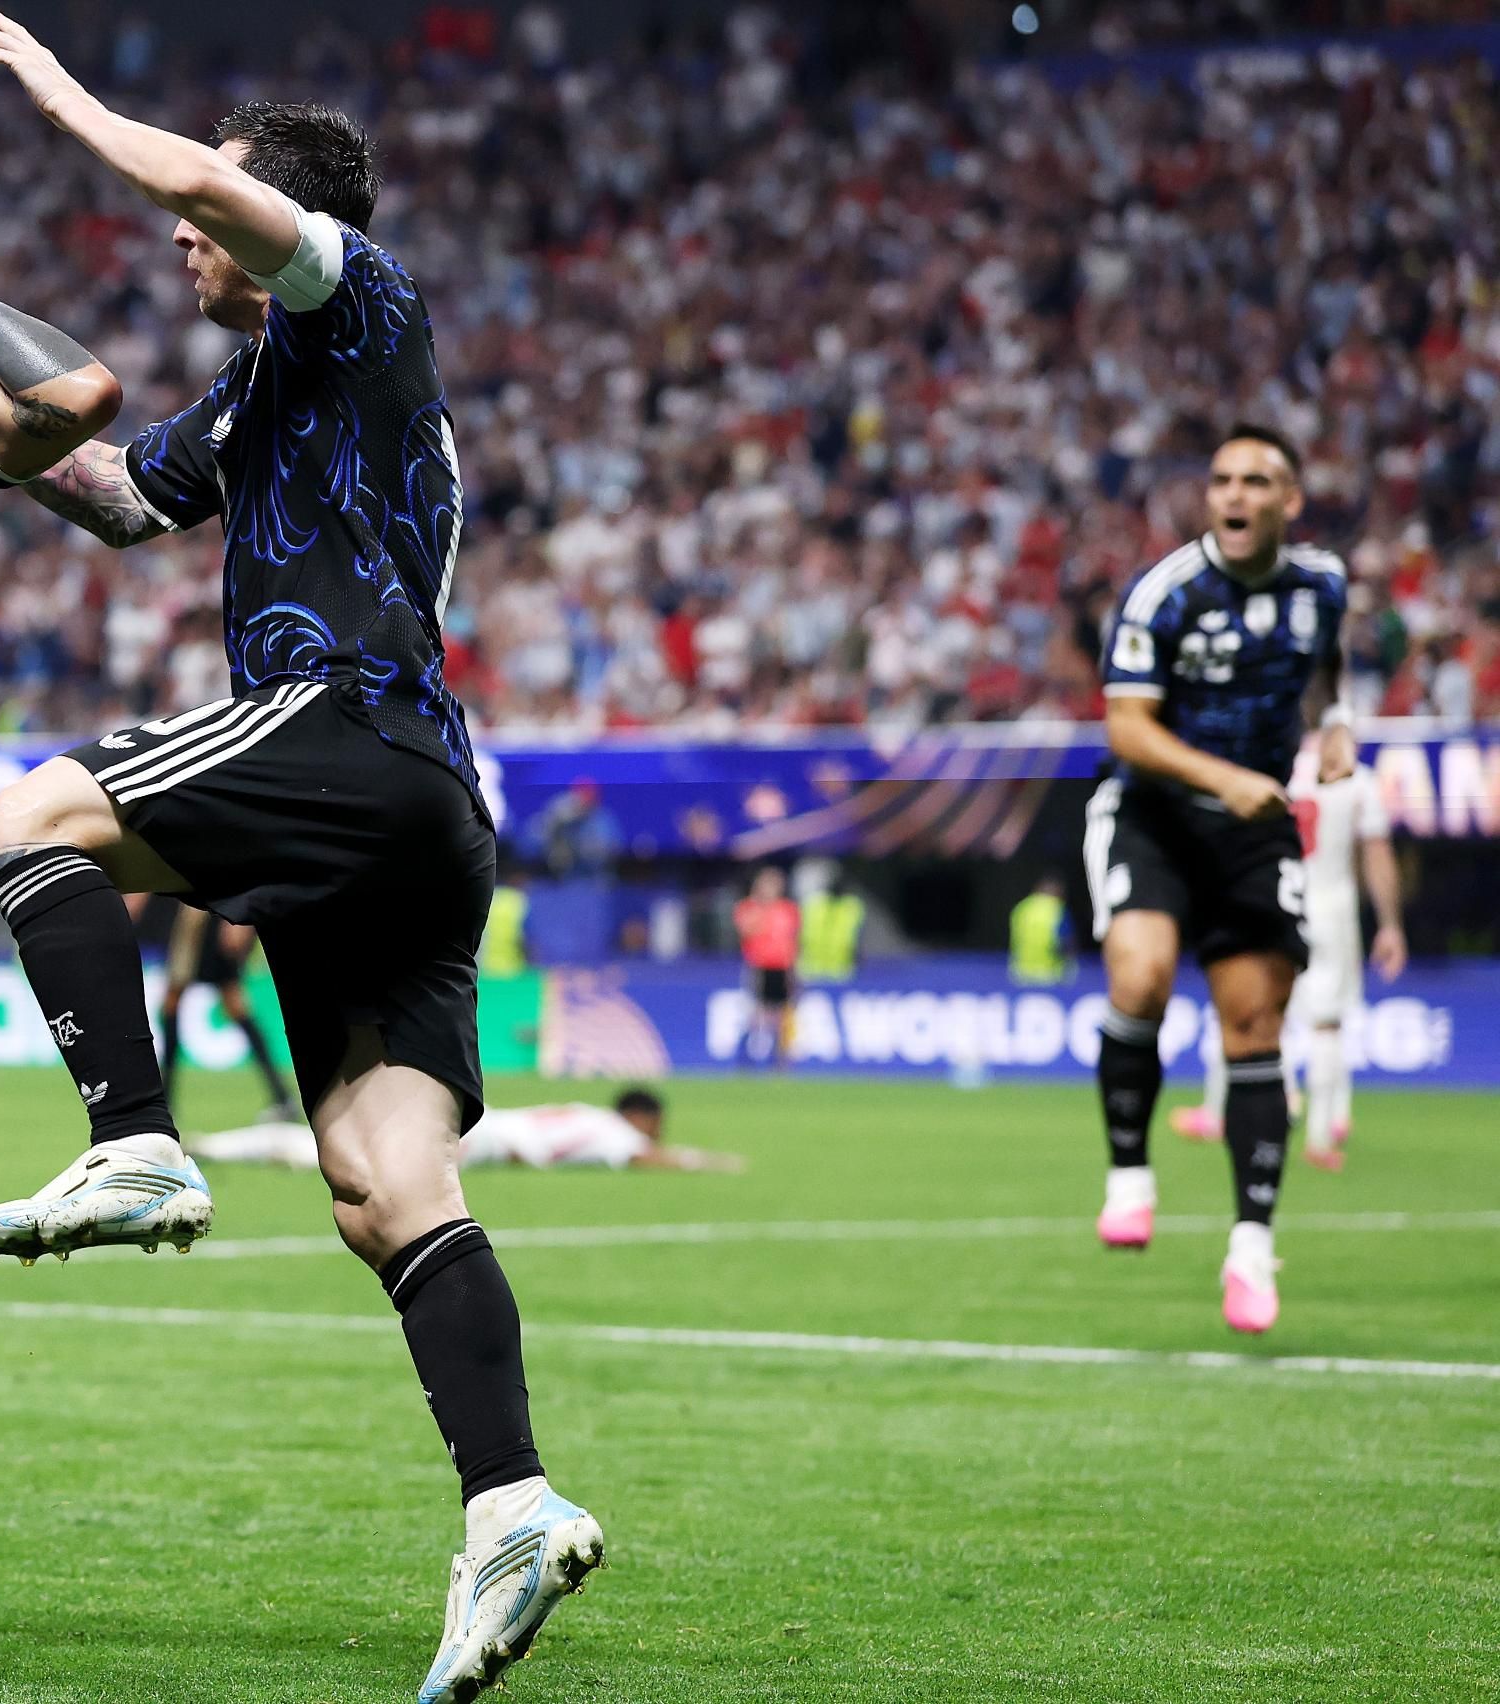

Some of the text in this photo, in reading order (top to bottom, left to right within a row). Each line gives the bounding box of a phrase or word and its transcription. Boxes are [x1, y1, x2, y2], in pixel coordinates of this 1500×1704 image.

[706, 989, 842, 1062] FA
[842, 990, 1066, 1065] WORLD
[1068, 993, 1200, 1068] CP
